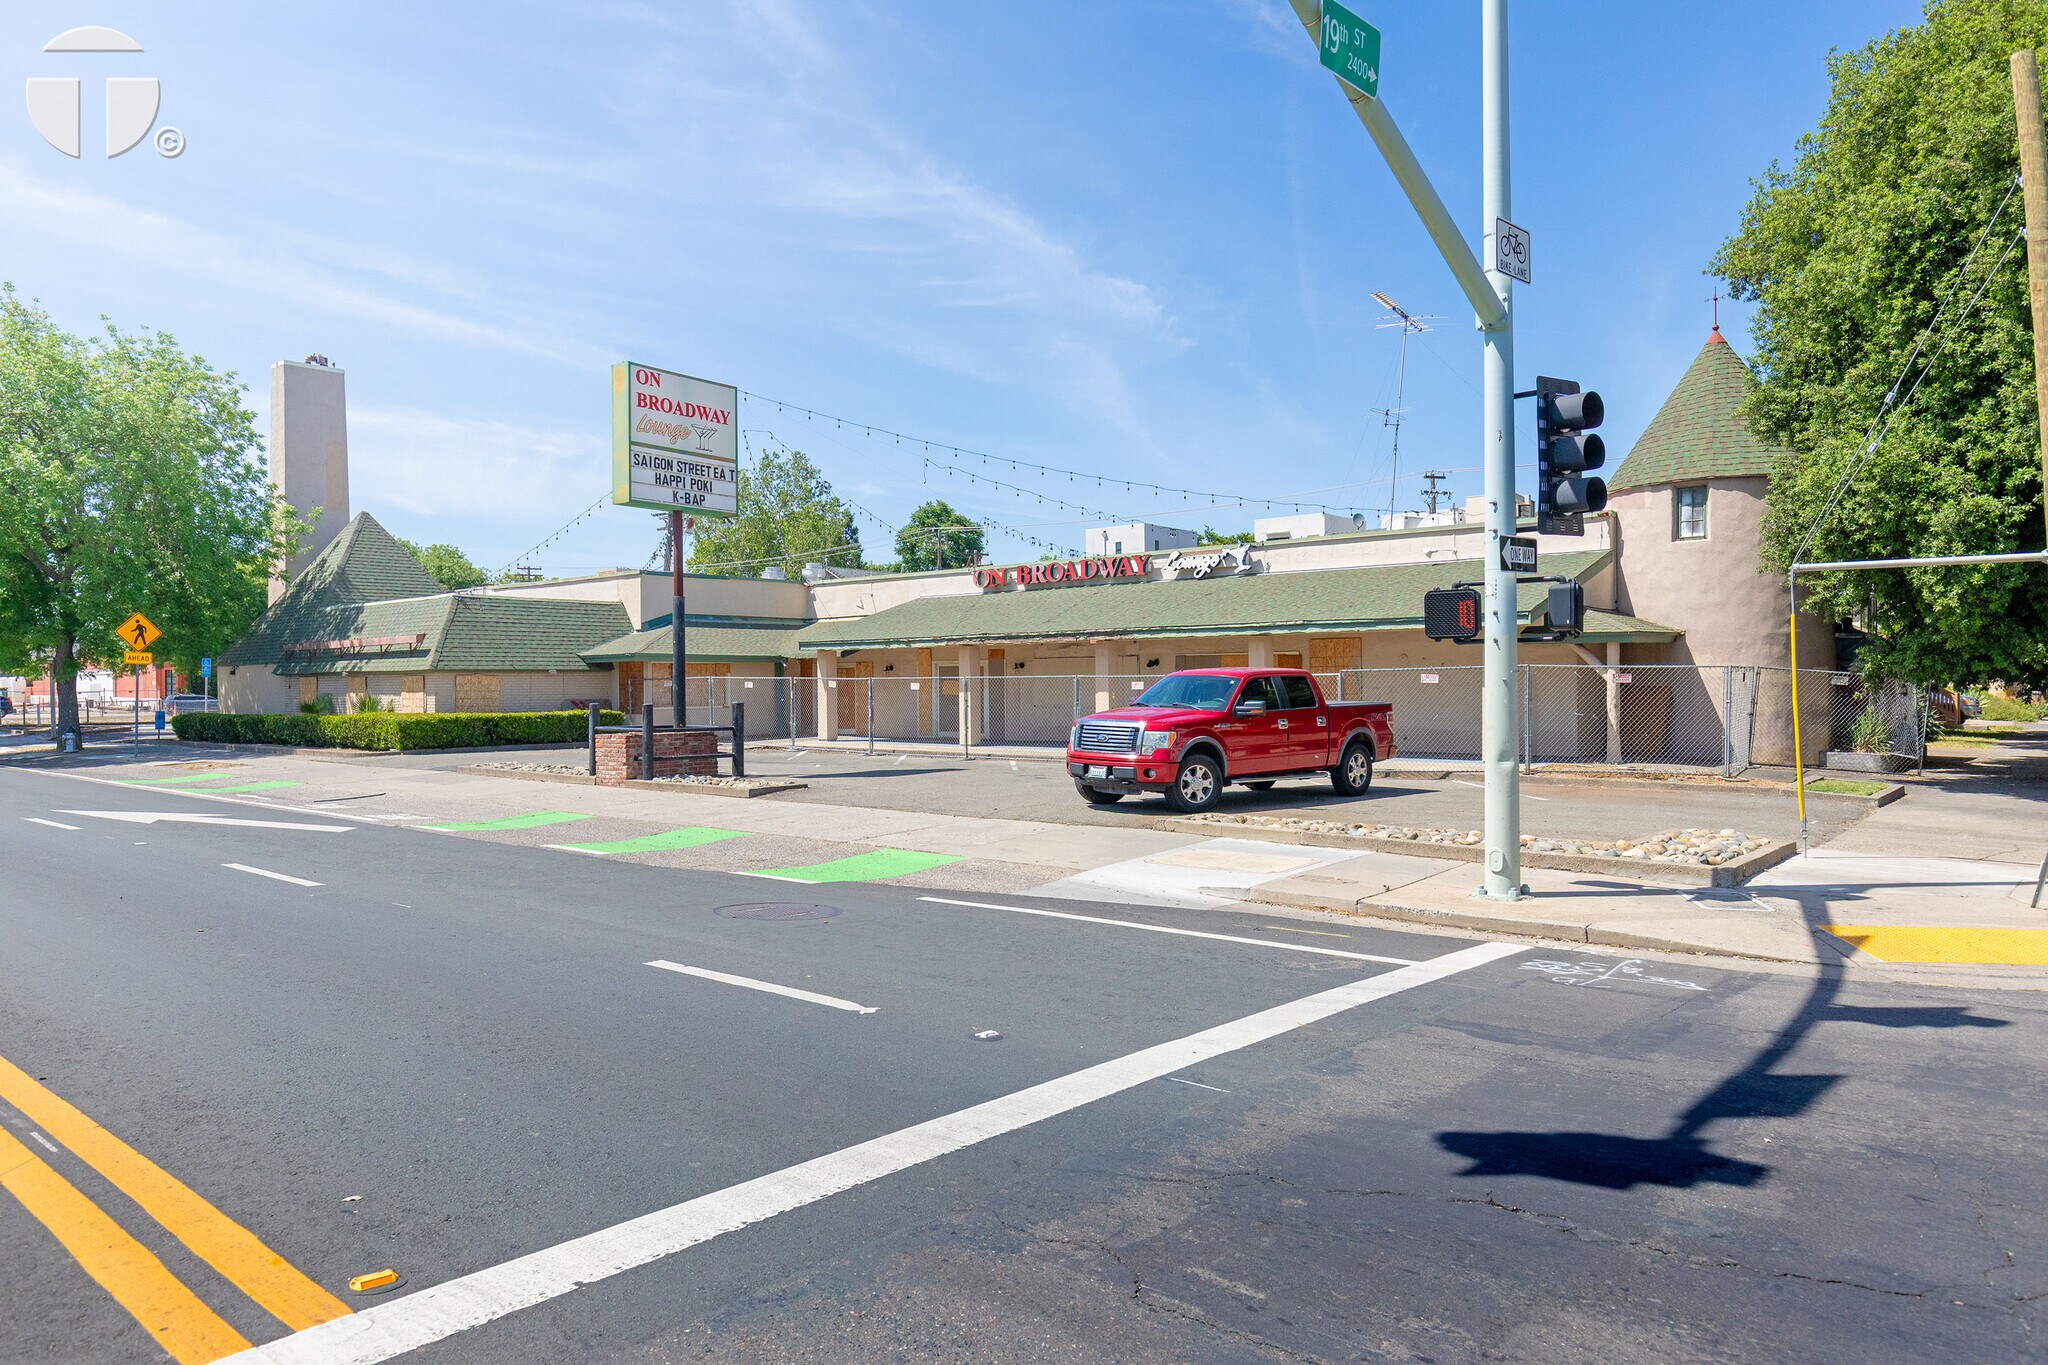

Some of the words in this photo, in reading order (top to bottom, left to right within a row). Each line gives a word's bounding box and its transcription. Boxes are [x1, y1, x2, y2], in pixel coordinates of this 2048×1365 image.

[1323, 14, 1349, 54] 19th
[1354, 28, 1366, 49] ST
[1347, 52, 1368, 80] 2400
[1500, 258, 1512, 273] BIKE
[1514, 265, 1527, 280] LANE
[635, 369, 661, 388] ON
[635, 391, 731, 426] BROADWAY
[635, 413, 692, 445] Lounge
[633, 453, 674, 473] SAIGON
[676, 461, 712, 478] STREET
[655, 472, 686, 489] HAPPI
[690, 478, 713, 493] POKI
[672, 490, 706, 506] K-BAP
[1510, 547, 1522, 562] ONE
[1522, 548, 1534, 563] WAY
[973, 567, 1006, 588] ON
[1015, 554, 1151, 586] BROADWAY
[1161, 550, 1222, 579] Lounge
[127, 654, 150, 662] AHEAD
